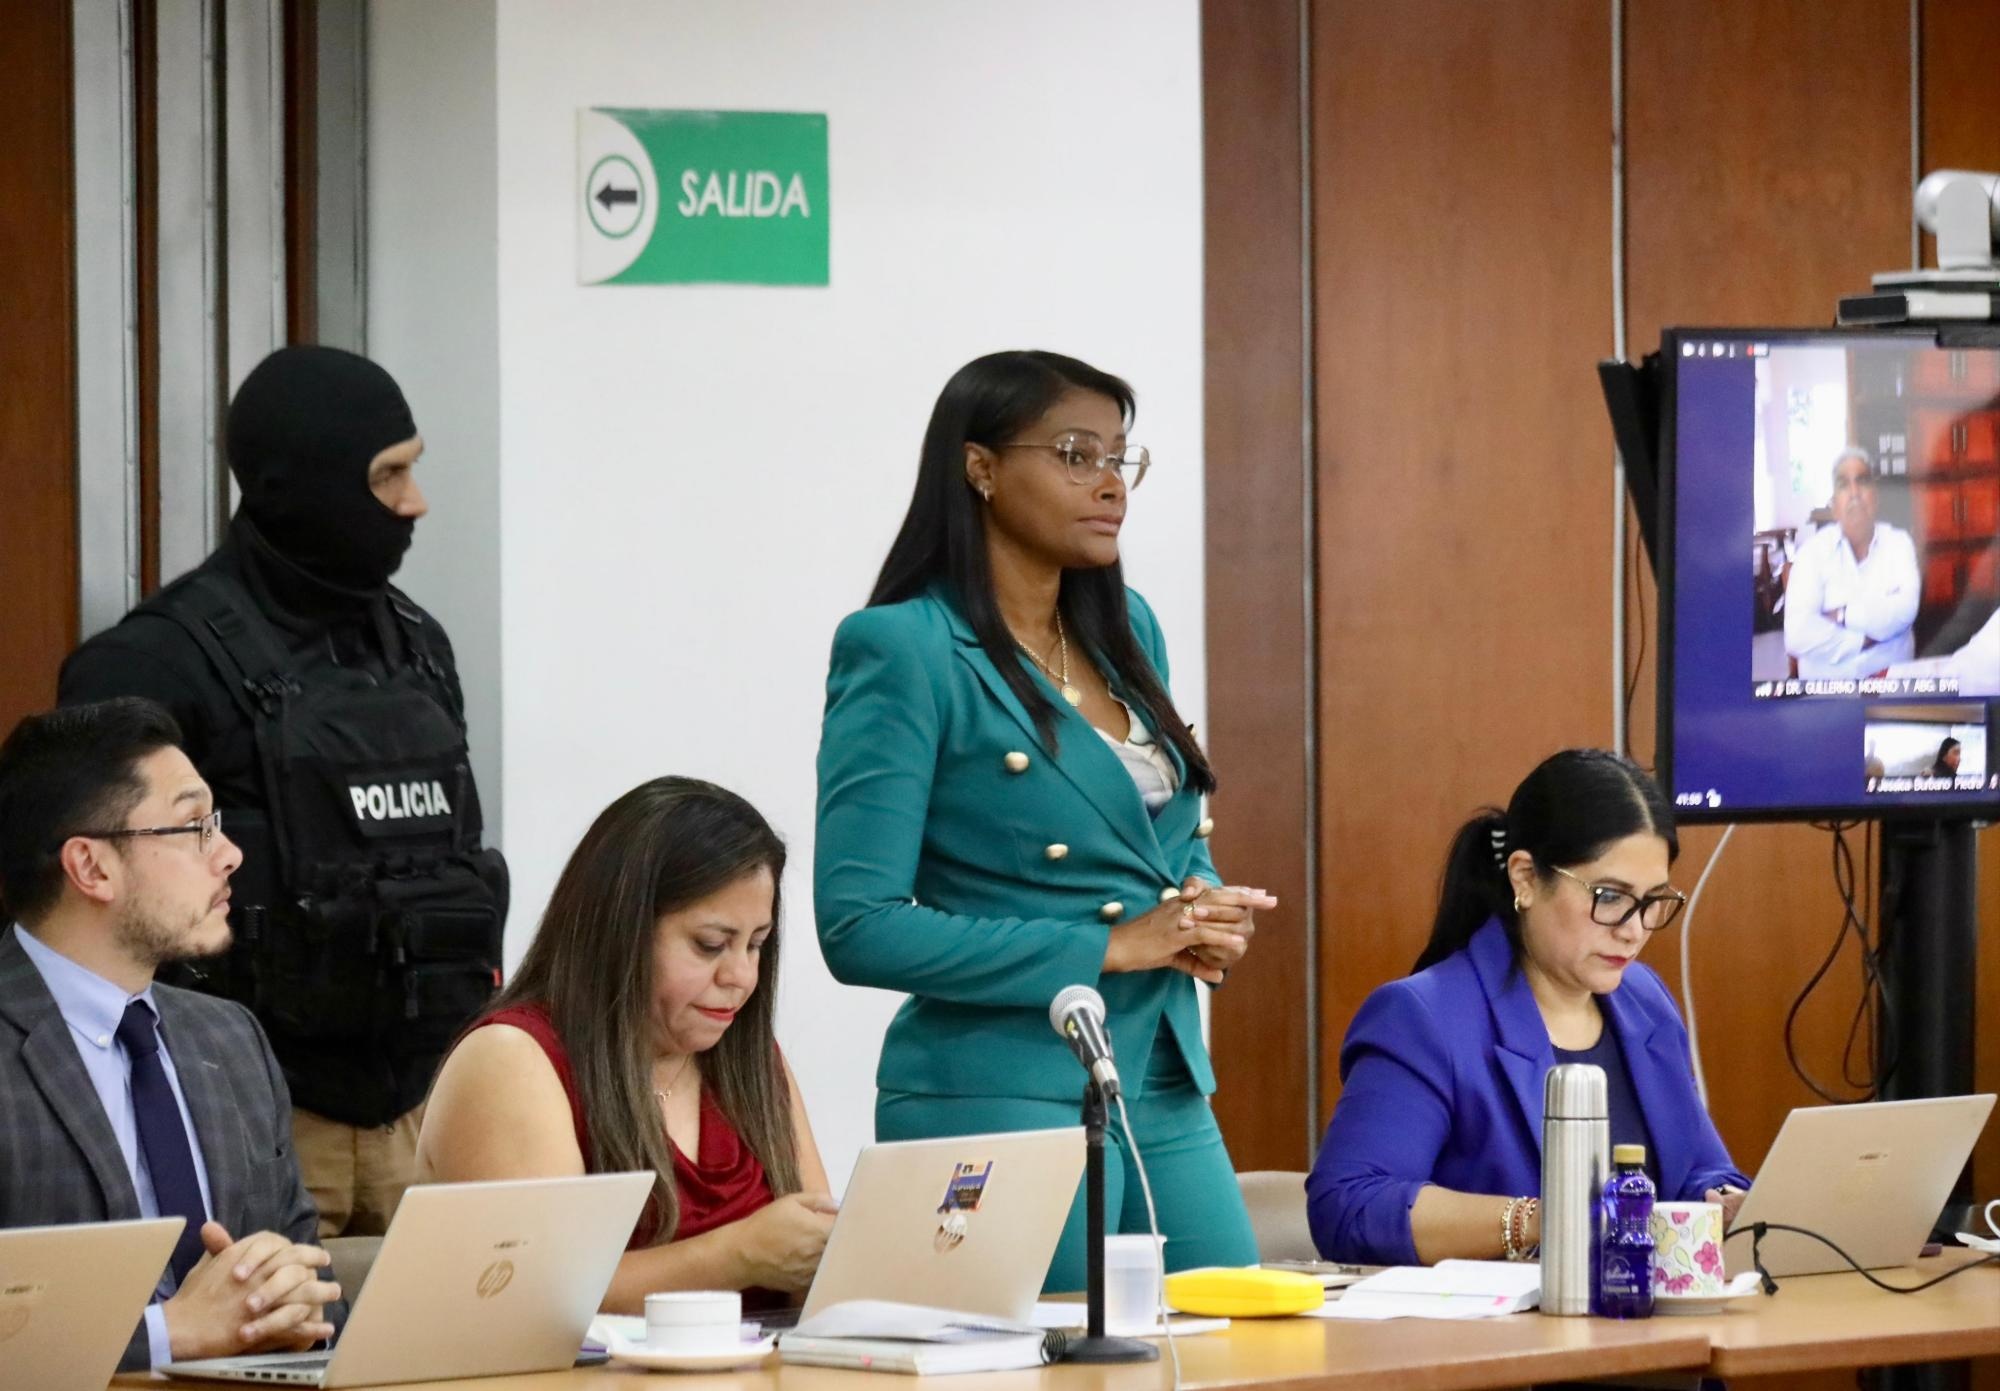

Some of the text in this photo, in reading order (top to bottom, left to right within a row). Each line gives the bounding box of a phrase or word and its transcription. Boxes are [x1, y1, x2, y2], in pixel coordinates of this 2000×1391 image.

[677, 168, 811, 218] SALIDA
[1805, 678, 1856, 695] GUILLERMO
[1858, 678, 1900, 694] MORENO
[1902, 678, 1911, 693] Y
[349, 780, 453, 821] POLICIA
